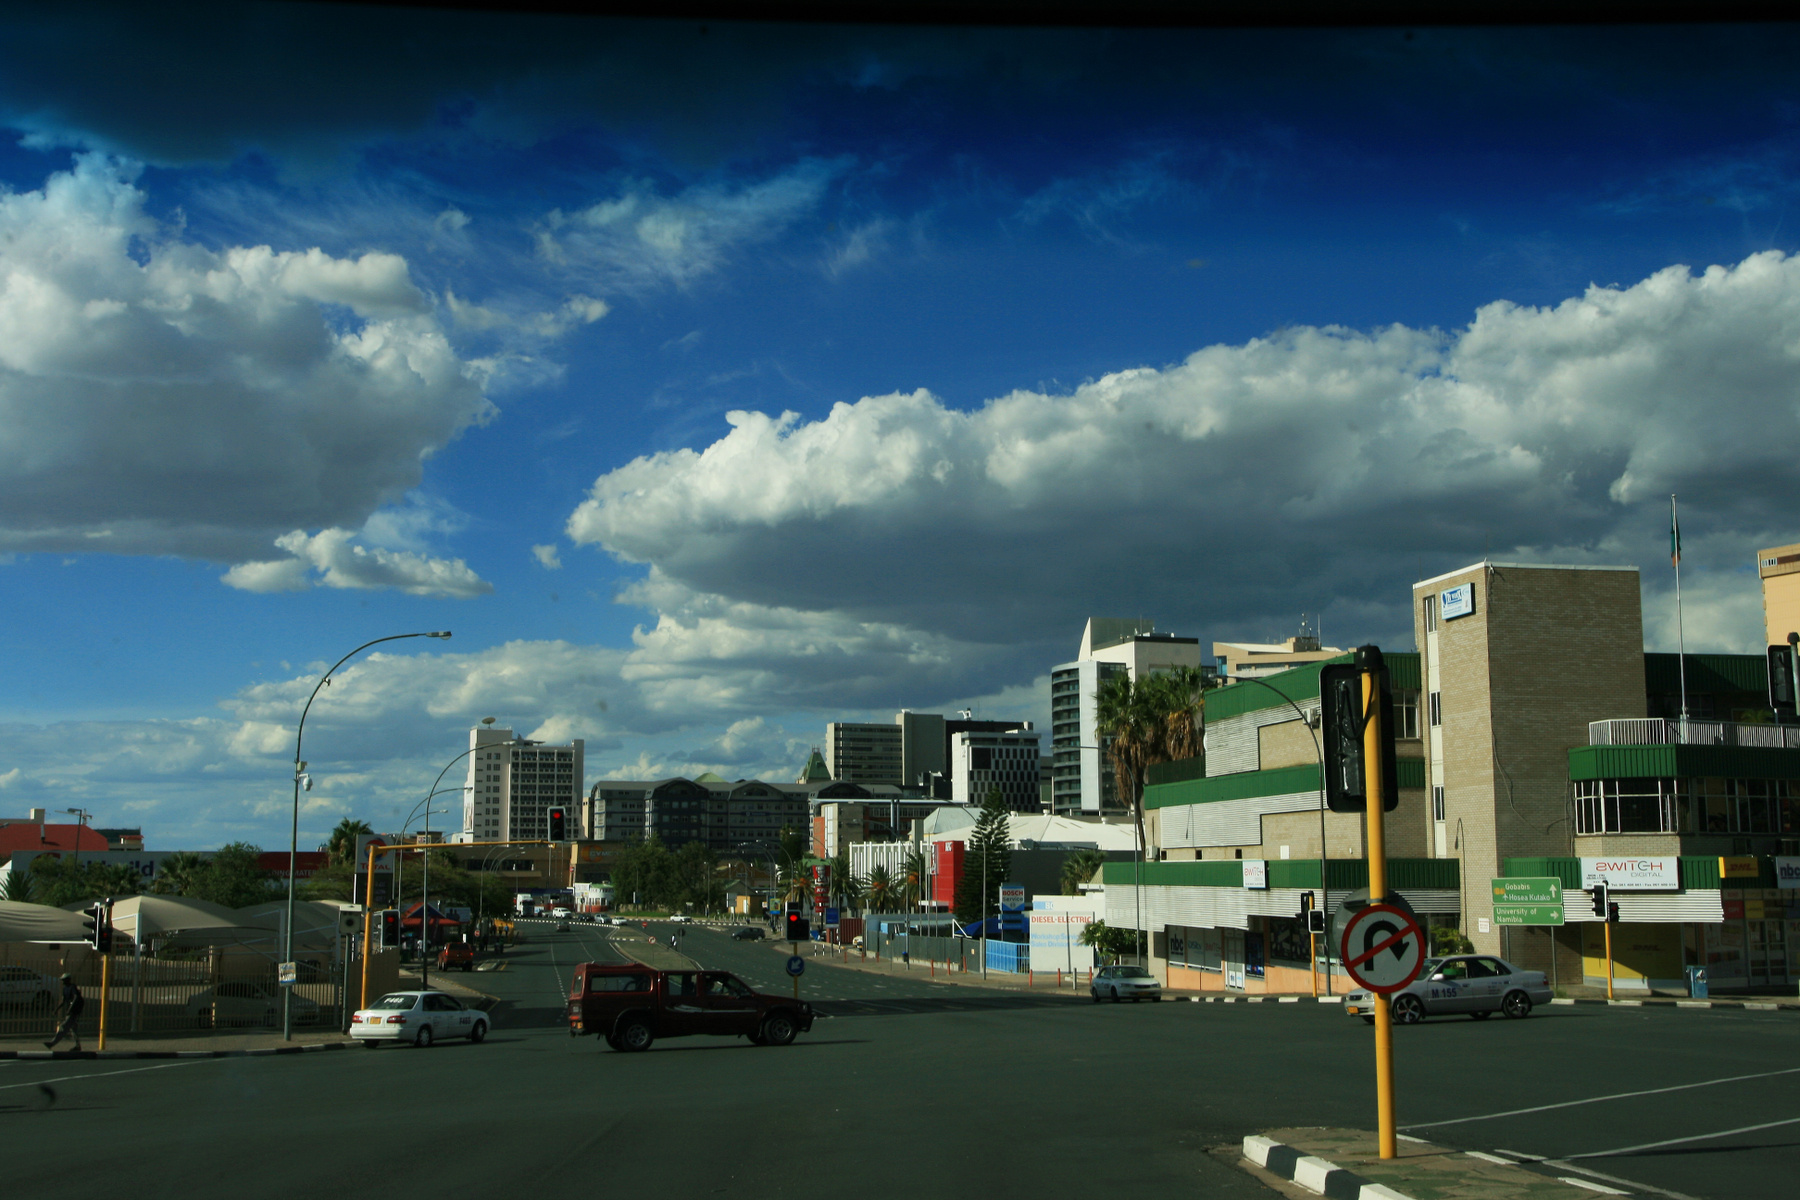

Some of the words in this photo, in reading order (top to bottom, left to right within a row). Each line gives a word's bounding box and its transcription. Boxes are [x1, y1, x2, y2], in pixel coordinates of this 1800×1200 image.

[1496, 907, 1528, 916] University
[1432, 989, 1439, 998] M
[1442, 988, 1457, 998] 155
